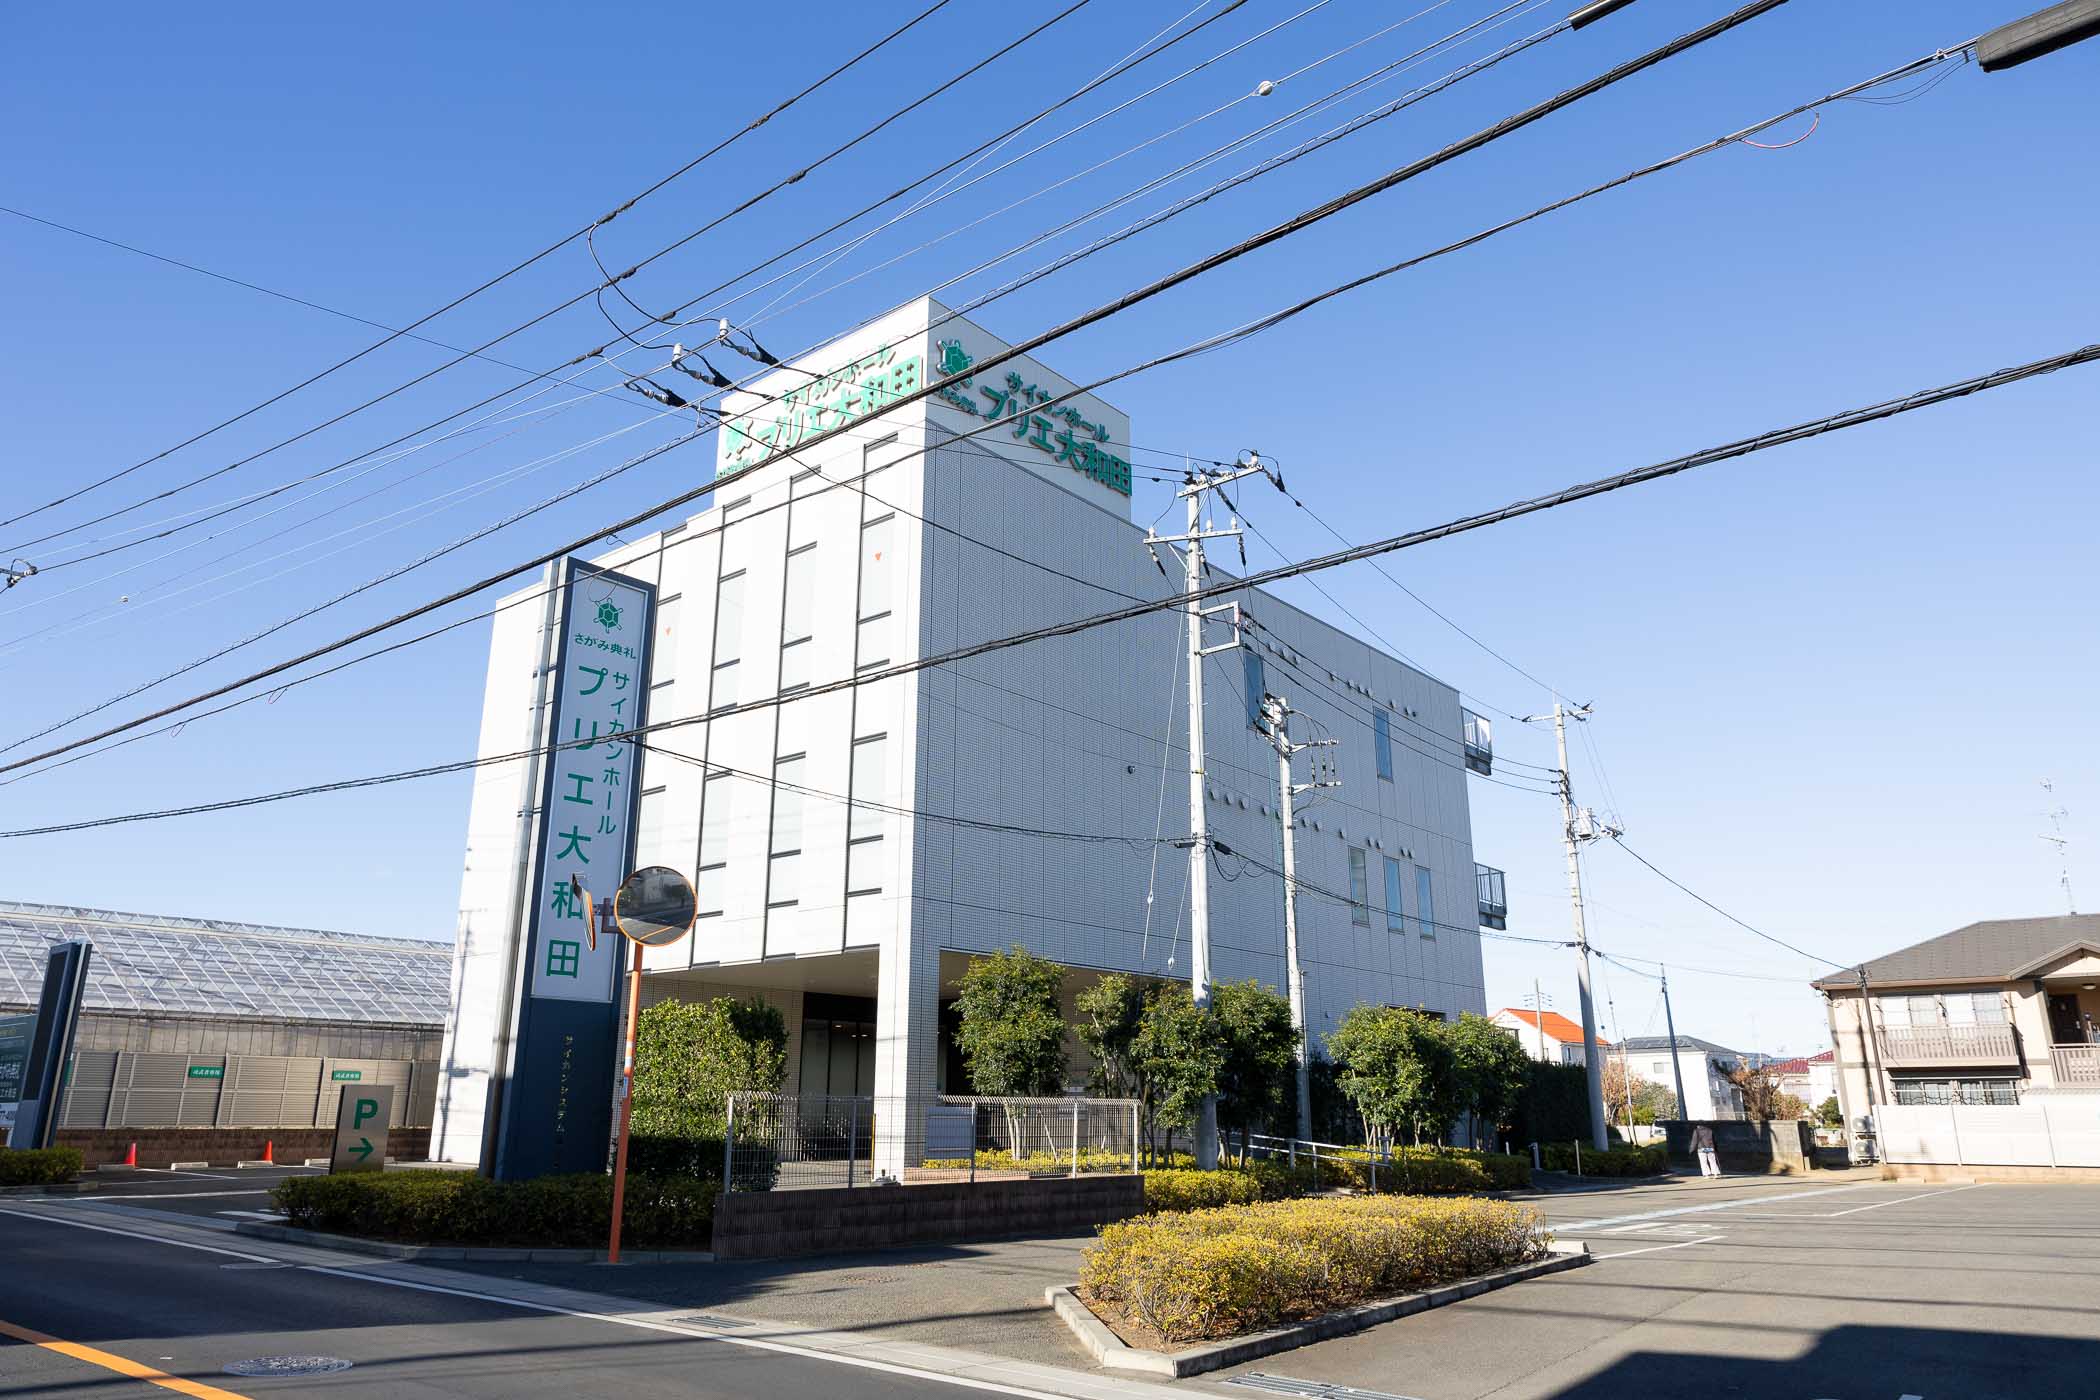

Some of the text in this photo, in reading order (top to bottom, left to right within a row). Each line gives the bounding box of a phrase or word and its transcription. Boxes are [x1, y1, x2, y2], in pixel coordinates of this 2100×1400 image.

[979, 384, 1132, 497] プリエ大和田
[1005, 371, 1110, 443] サイカンホール
[574, 633, 638, 659] さがみ典礼
[597, 671, 631, 834] サイカンホール
[546, 665, 609, 979] プリエ大和田
[353, 1098, 378, 1130] P
